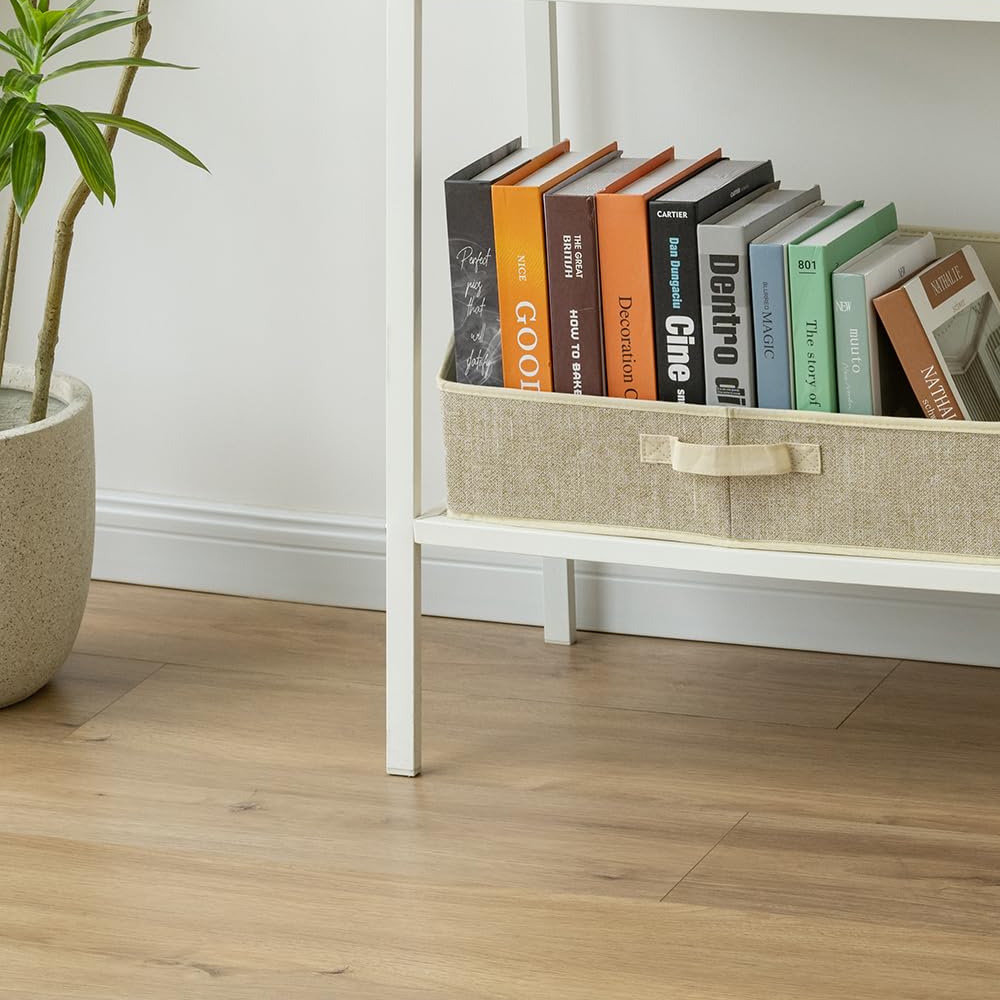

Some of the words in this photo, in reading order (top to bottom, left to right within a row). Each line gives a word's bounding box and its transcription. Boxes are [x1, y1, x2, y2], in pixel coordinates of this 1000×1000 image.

[656, 210, 689, 219] CARTIER
[562, 234, 574, 279] BRITISH
[574, 234, 583, 250] THE
[668, 237, 679, 257] Dan
[517, 255, 528, 281] NICE
[575, 251, 584, 279] GREAT
[798, 260, 817, 270] 801
[930, 265, 963, 296] NATHALIE
[668, 260, 683, 309] Dungaciu
[569, 309, 580, 341] HOW
[709, 254, 741, 366] Dentro
[618, 296, 637, 383] Decoration
[762, 312, 775, 360] MAGIC
[805, 319, 818, 347] The
[570, 343, 580, 360] TO
[665, 315, 695, 383] Cine
[849, 328, 862, 374] muuto
[806, 352, 817, 388] story
[808, 389, 822, 408] of
